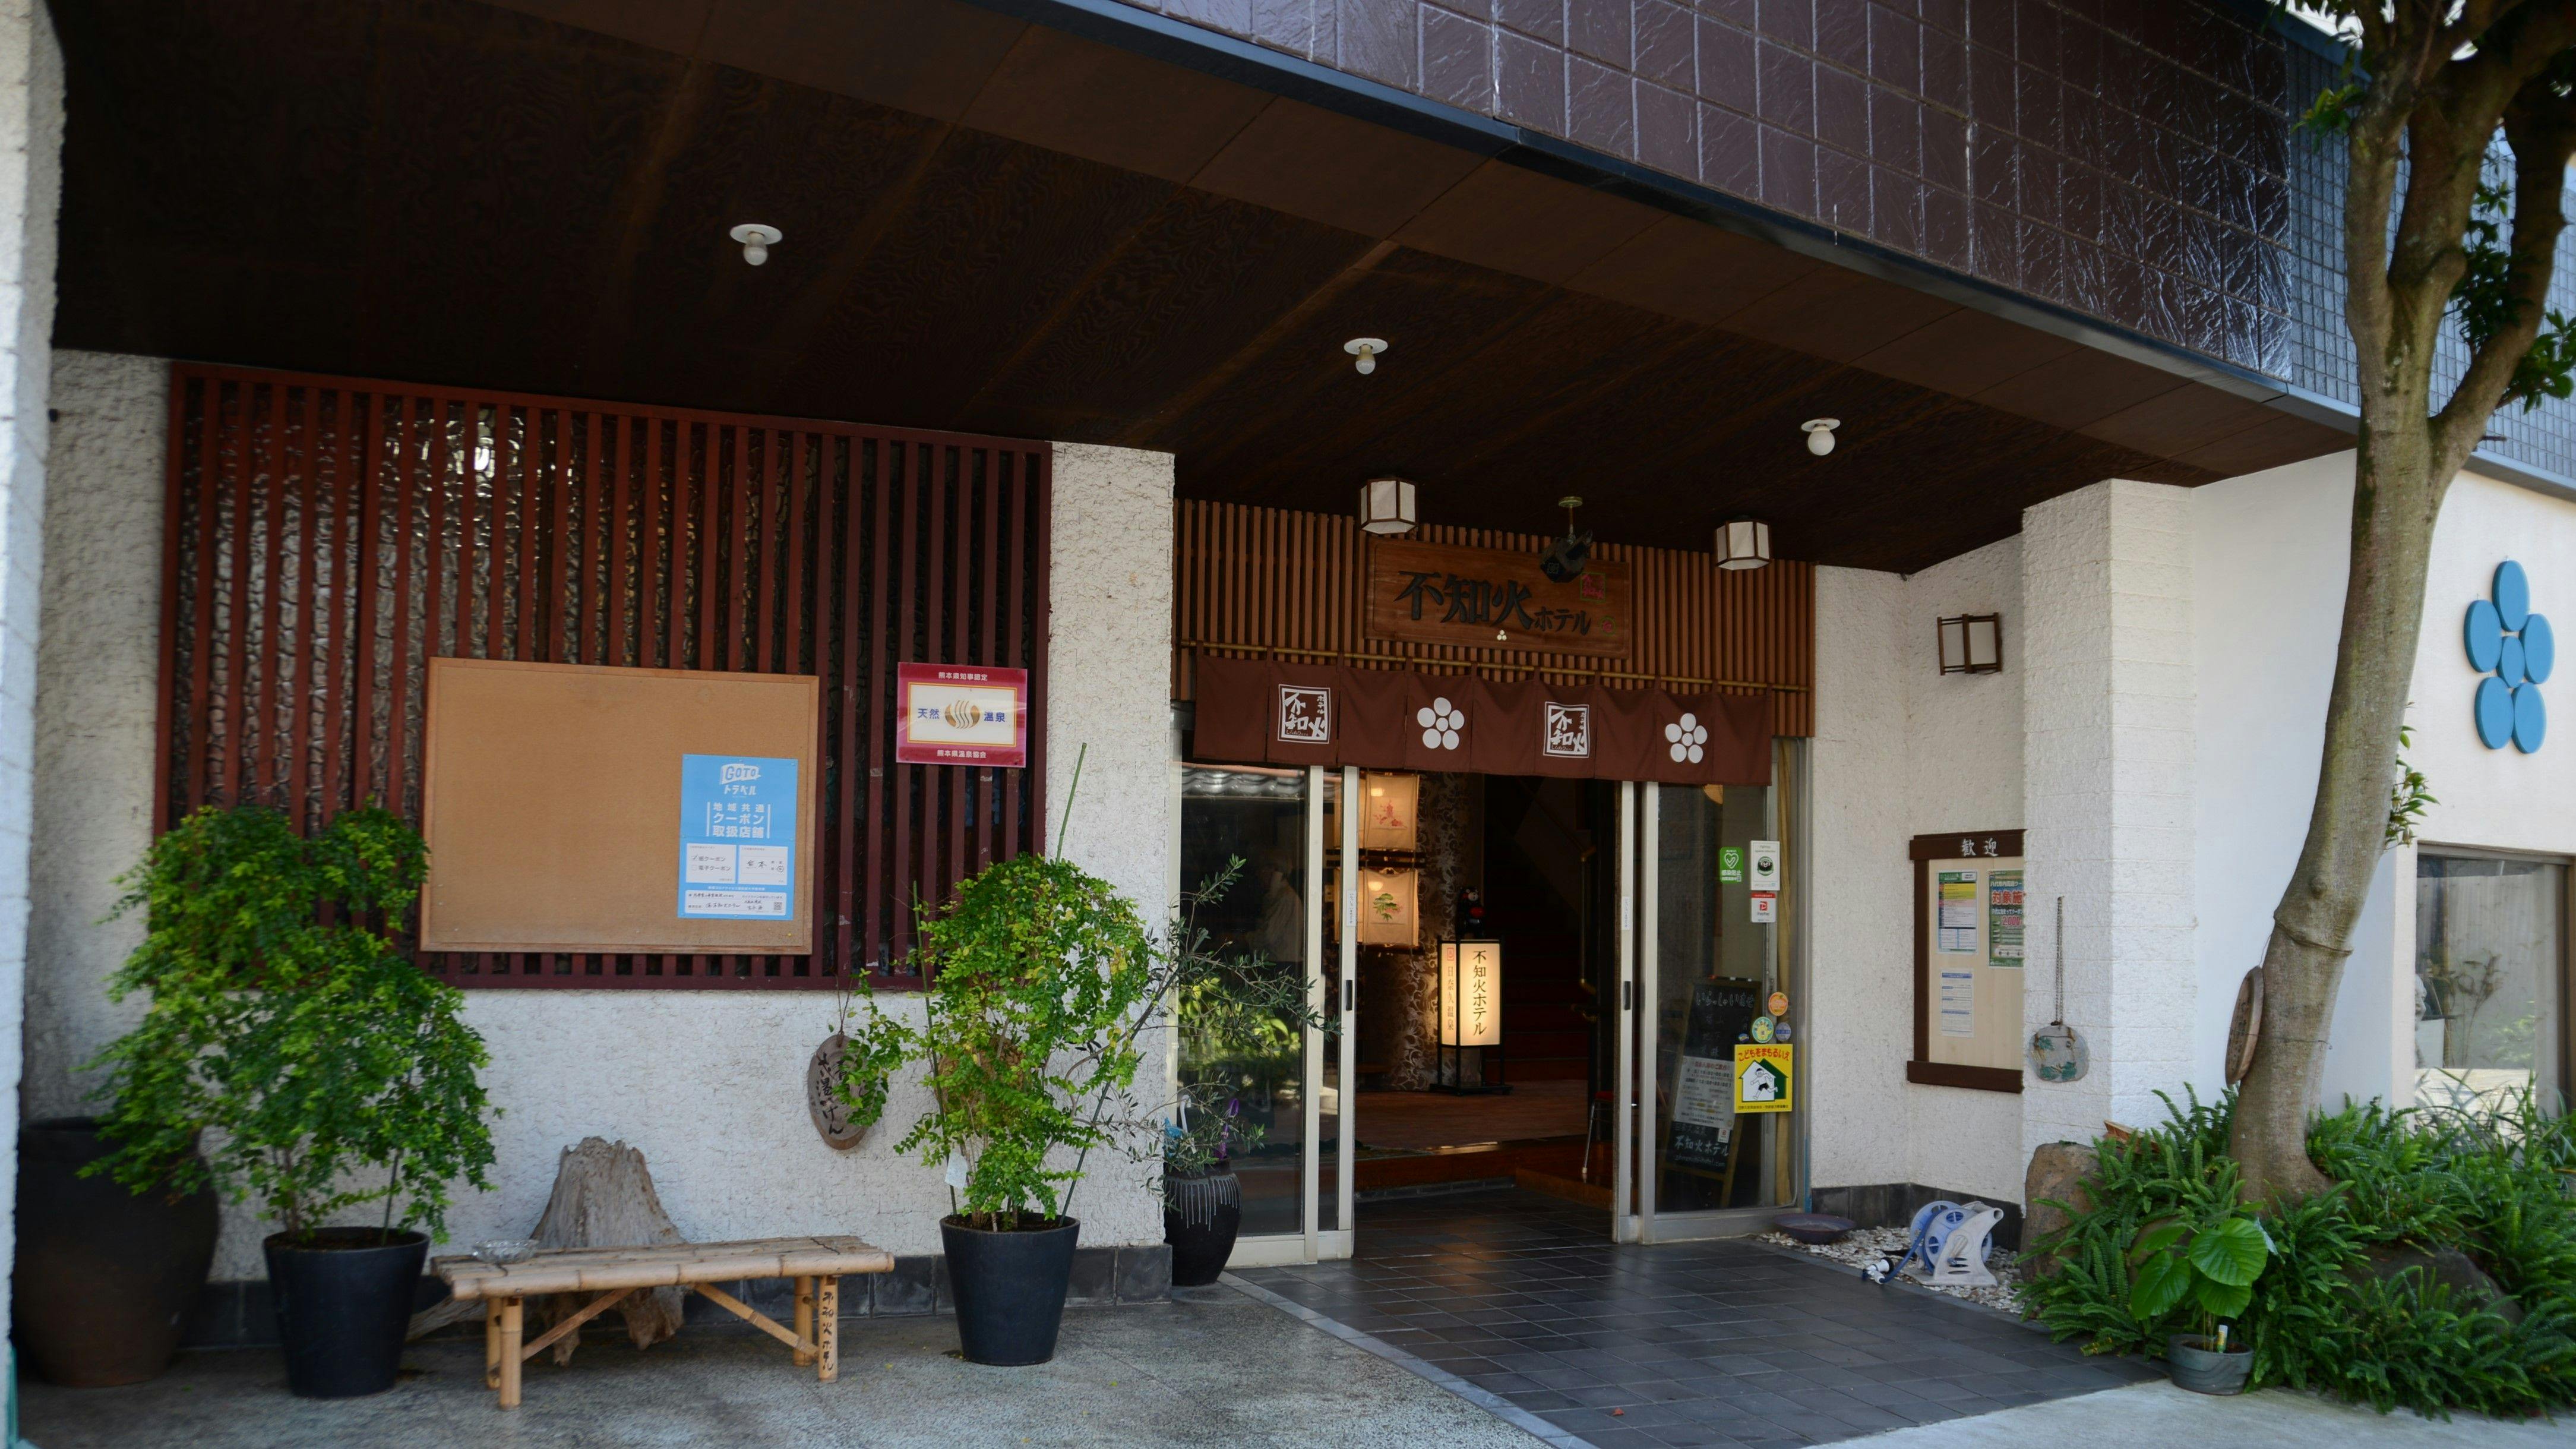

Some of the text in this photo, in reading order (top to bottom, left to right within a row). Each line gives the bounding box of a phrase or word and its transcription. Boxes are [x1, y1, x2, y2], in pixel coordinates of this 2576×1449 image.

[1393, 570, 1591, 636] 不知火ホテル
[917, 708, 1006, 723] 天然 温泉
[723, 784, 757, 795] トラベル
[713, 801, 765, 813] 地域共通
[713, 813, 764, 825] クーポン
[712, 825, 764, 838] 取扱店舗
[1961, 838, 1999, 857] 歓迎
[1472, 950, 1487, 1037] 不知火ホテル
[1737, 1047, 1791, 1062] こどもをまもるいえ
